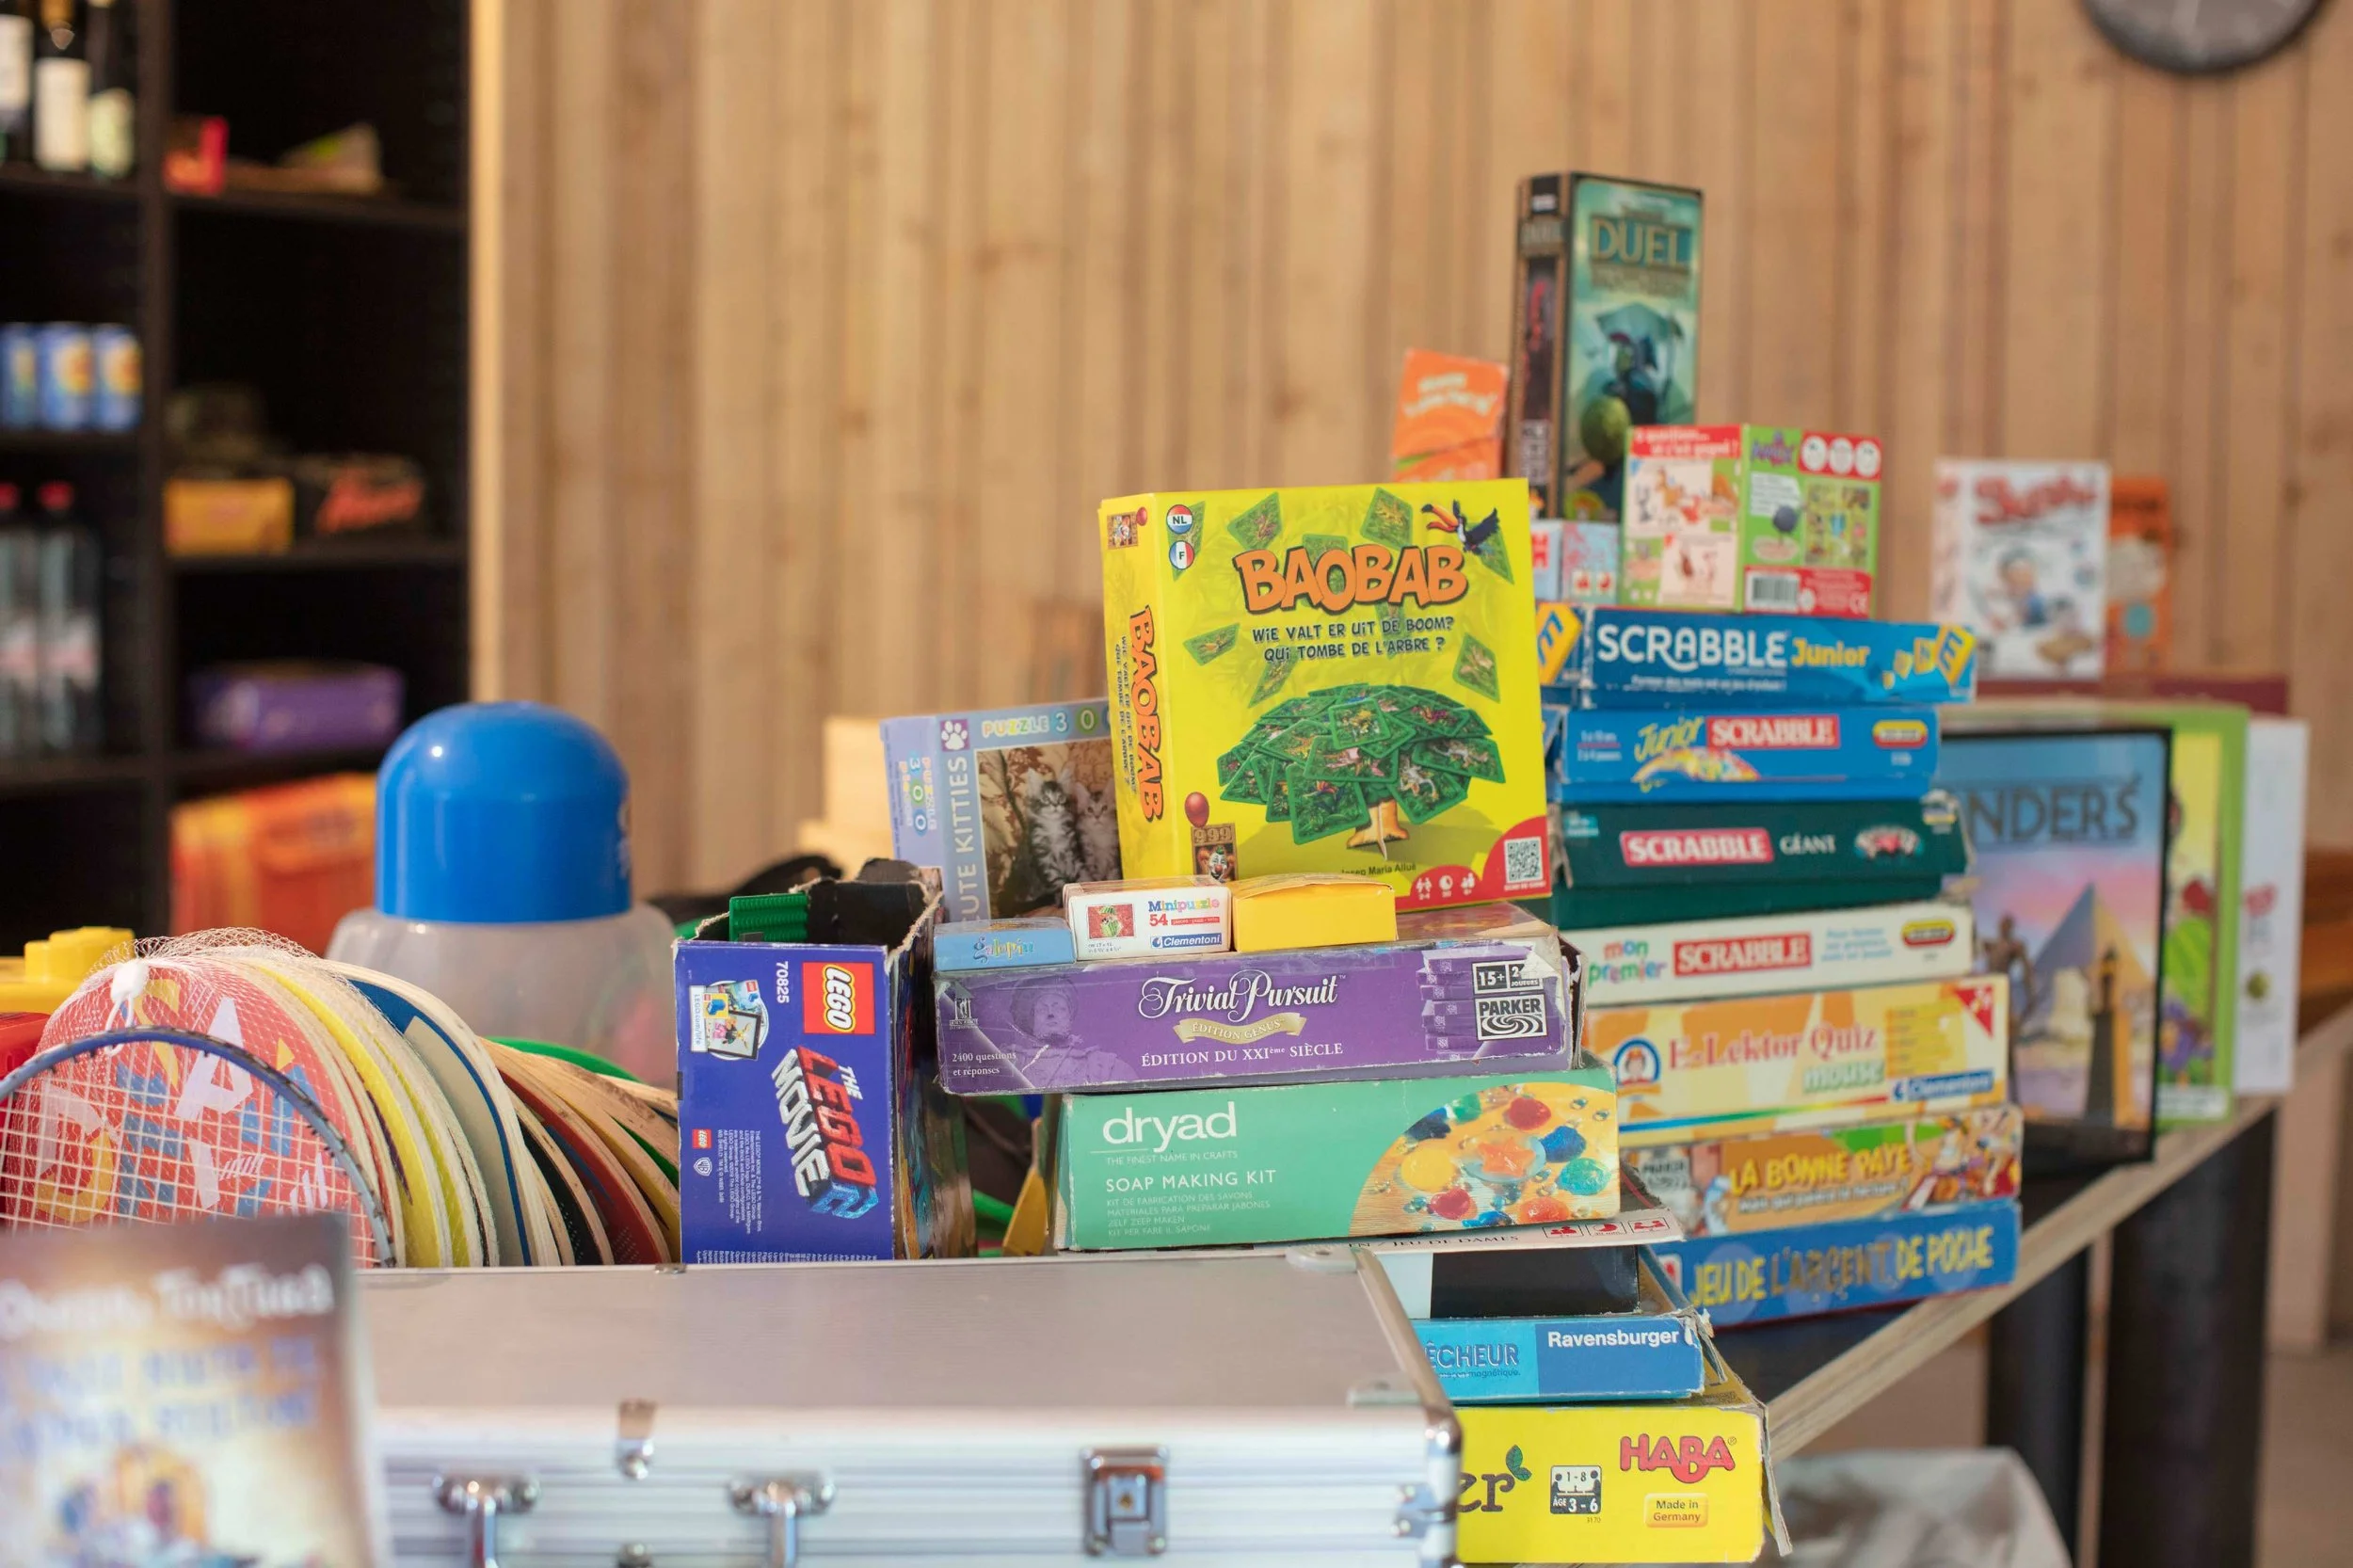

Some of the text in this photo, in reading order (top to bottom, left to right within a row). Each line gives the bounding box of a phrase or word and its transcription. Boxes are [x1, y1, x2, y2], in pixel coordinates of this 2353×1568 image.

[1593, 218, 1690, 269] DUEL
[1173, 516, 1187, 524] NL
[1178, 552, 1185, 560] F
[1232, 543, 1469, 615] BAOBAB
[1286, 624, 1321, 641] VALT
[1329, 623, 1346, 638] ER
[1382, 618, 1399, 633] DE
[1406, 616, 1454, 632] BOOM?
[1297, 643, 1346, 659] TOMBE
[1352, 641, 1369, 657] DE
[1376, 638, 1429, 654] L'ARBRE
[1597, 623, 1871, 672] SCRABBLE Junior
[1129, 603, 1164, 823] BAOBAB
[982, 714, 1049, 739] PUZZLE
[1634, 715, 1835, 762] Junior SCRABBLE
[948, 756, 975, 853] KITTIES
[1626, 833, 1837, 863] SCRABBLE GÉANT
[1148, 898, 1220, 912] Minipuzzle
[1149, 914, 1168, 926] 54
[1604, 940, 1648, 959] mon
[1677, 936, 1809, 973] SCRABBLE
[776, 961, 789, 1003] 70825
[1479, 970, 1505, 986] 15+
[1588, 958, 1666, 987] premier
[824, 966, 854, 1031] LEGO
[1138, 976, 1239, 1019] Trivial
[1479, 999, 1542, 1016] PARKER
[1192, 1022, 1241, 1040] ÉDITION
[1810, 1023, 1877, 1062] Quiz
[952, 1051, 1017, 1064] 2400 questions
[1141, 1042, 1343, 1067] ÉDITION DU XXIème SIÈCLE
[839, 1065, 863, 1100] THE
[962, 1065, 1000, 1078] réponses
[1801, 1062, 1884, 1094] mouse
[771, 1048, 830, 1196] MOVIE
[798, 1047, 877, 1188] LEGO
[1102, 1100, 1238, 1153] dryad
[1107, 1150, 1239, 1165] THE FINEST NAME IN CRAFTS
[1728, 1143, 1911, 1197] LA BONNE PAYE
[1106, 1169, 1277, 1192] SOAP MAKING KIT
[1107, 1201, 1271, 1217] MATERIALES PARA PREPARAR JABONES
[1137, 1193, 1195, 1206] FABRICATION
[1198, 1193, 1215, 1202] DES
[1217, 1192, 1254, 1201] SAVONS
[1124, 1227, 1140, 1237] PER
[1176, 1224, 1211, 1234] SAPONE
[1154, 1216, 1185, 1224] MAKEN
[1458, 1235, 1519, 1243] DAMES
[1689, 1225, 1993, 1307] JEU DE L'ARGENT DE POCHE
[1547, 1329, 1679, 1349] Ravensburger
[1553, 1496, 1567, 1507] ÂGE
[1656, 1499, 1699, 1511] Made in
[1653, 1512, 1702, 1524] Germany
